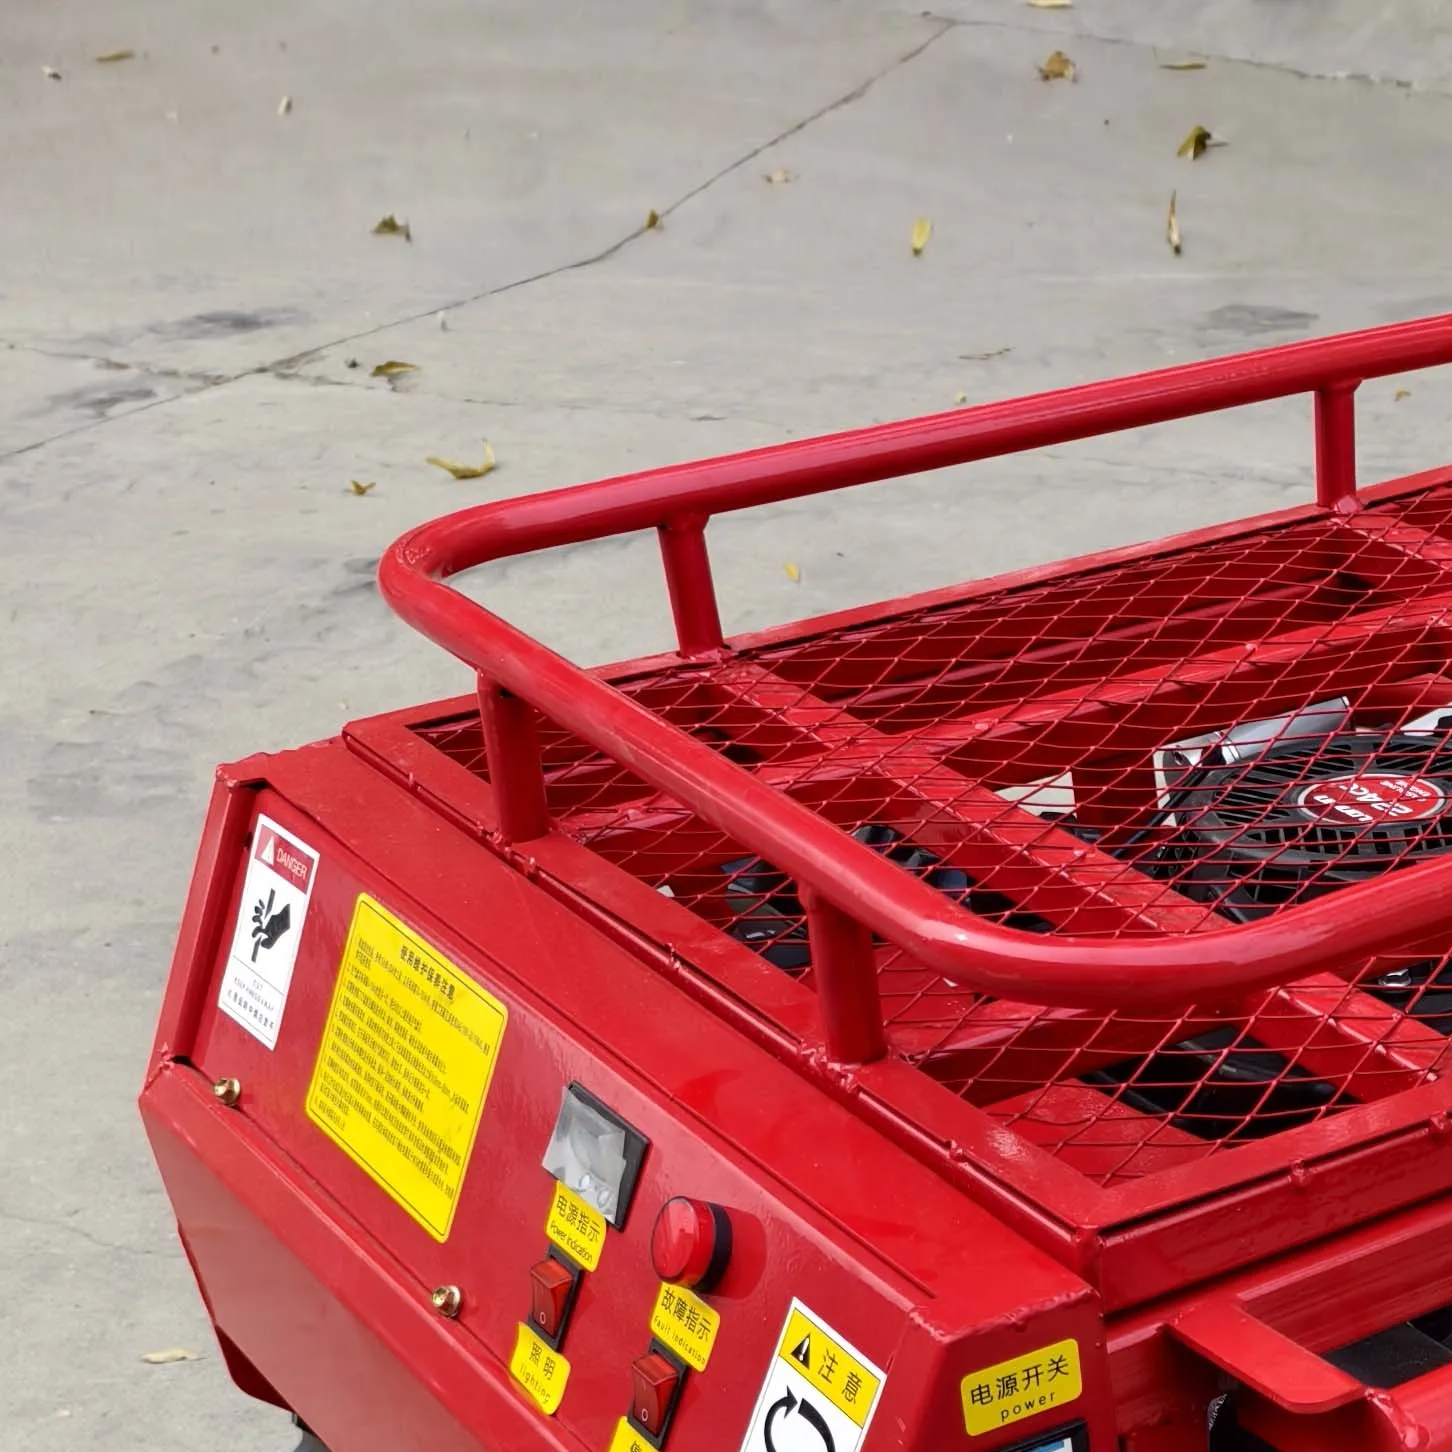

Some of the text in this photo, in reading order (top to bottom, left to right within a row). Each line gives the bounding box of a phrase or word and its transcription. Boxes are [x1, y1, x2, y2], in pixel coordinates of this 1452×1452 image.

[276, 847, 308, 880] DANGER
[550, 1220, 567, 1245] Power
[556, 1194, 601, 1243] 电源指示
[661, 1287, 712, 1343] 故障指示
[529, 1341, 557, 1381] 照明
[653, 1315, 706, 1365] Fault indication
[817, 1347, 863, 1405] 注意
[970, 1354, 1070, 1407] 电源开关
[1000, 1389, 1056, 1422] power
